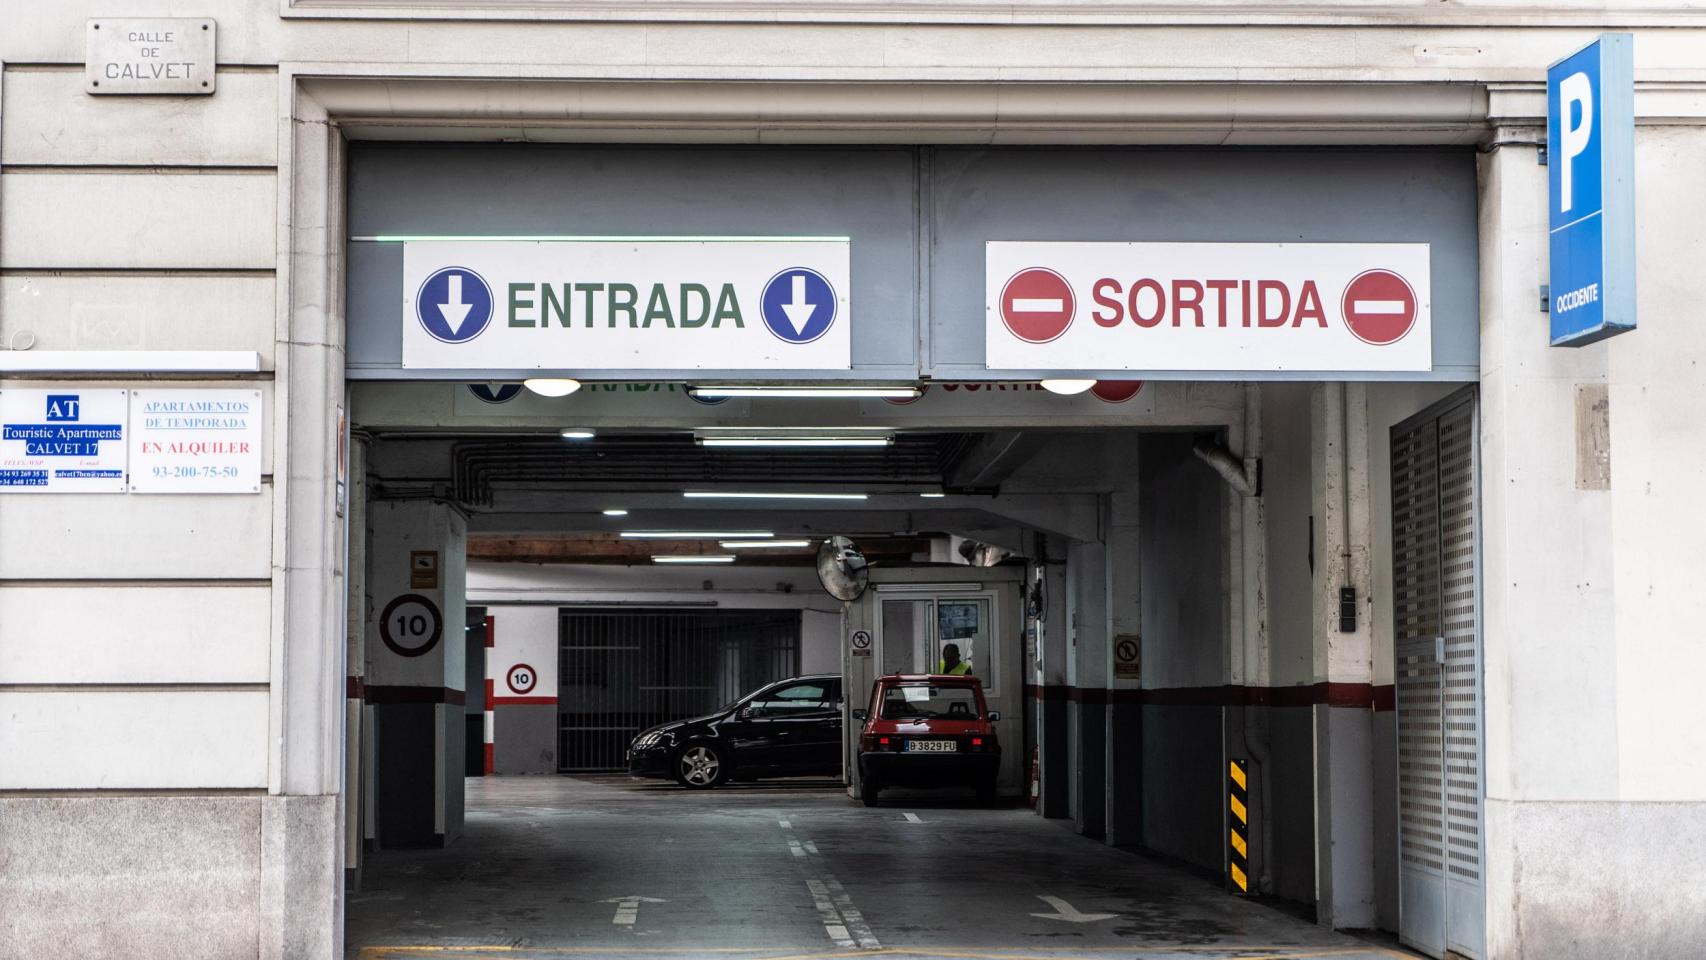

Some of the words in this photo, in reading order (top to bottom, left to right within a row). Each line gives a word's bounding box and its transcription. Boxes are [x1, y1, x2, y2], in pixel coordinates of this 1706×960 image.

[128, 32, 174, 42] CALLE
[141, 47, 159, 57] DE
[106, 63, 195, 79] CALVET
[1560, 71, 1593, 213] P
[1093, 278, 1328, 328] SORTIDA
[1557, 283, 1599, 313] OCCIDENTE
[509, 283, 744, 328] ENTRADA
[47, 400, 79, 418] AT
[144, 401, 250, 412] APARTAMENTOS
[146, 418, 161, 427] DE
[167, 418, 247, 427] TEMPORADA
[4, 426, 53, 438] Touristic
[57, 427, 122, 440] Apartments
[26, 442, 81, 454] CALVET
[86, 443, 98, 454] 17
[142, 442, 162, 453] EN
[168, 441, 250, 454] ALQUILER
[153, 466, 239, 478] 93-200-75-50
[397, 615, 427, 636] 10
[514, 673, 529, 685] 10
[910, 742, 916, 750] B
[918, 742, 942, 750] 3829
[943, 742, 955, 750] FU
